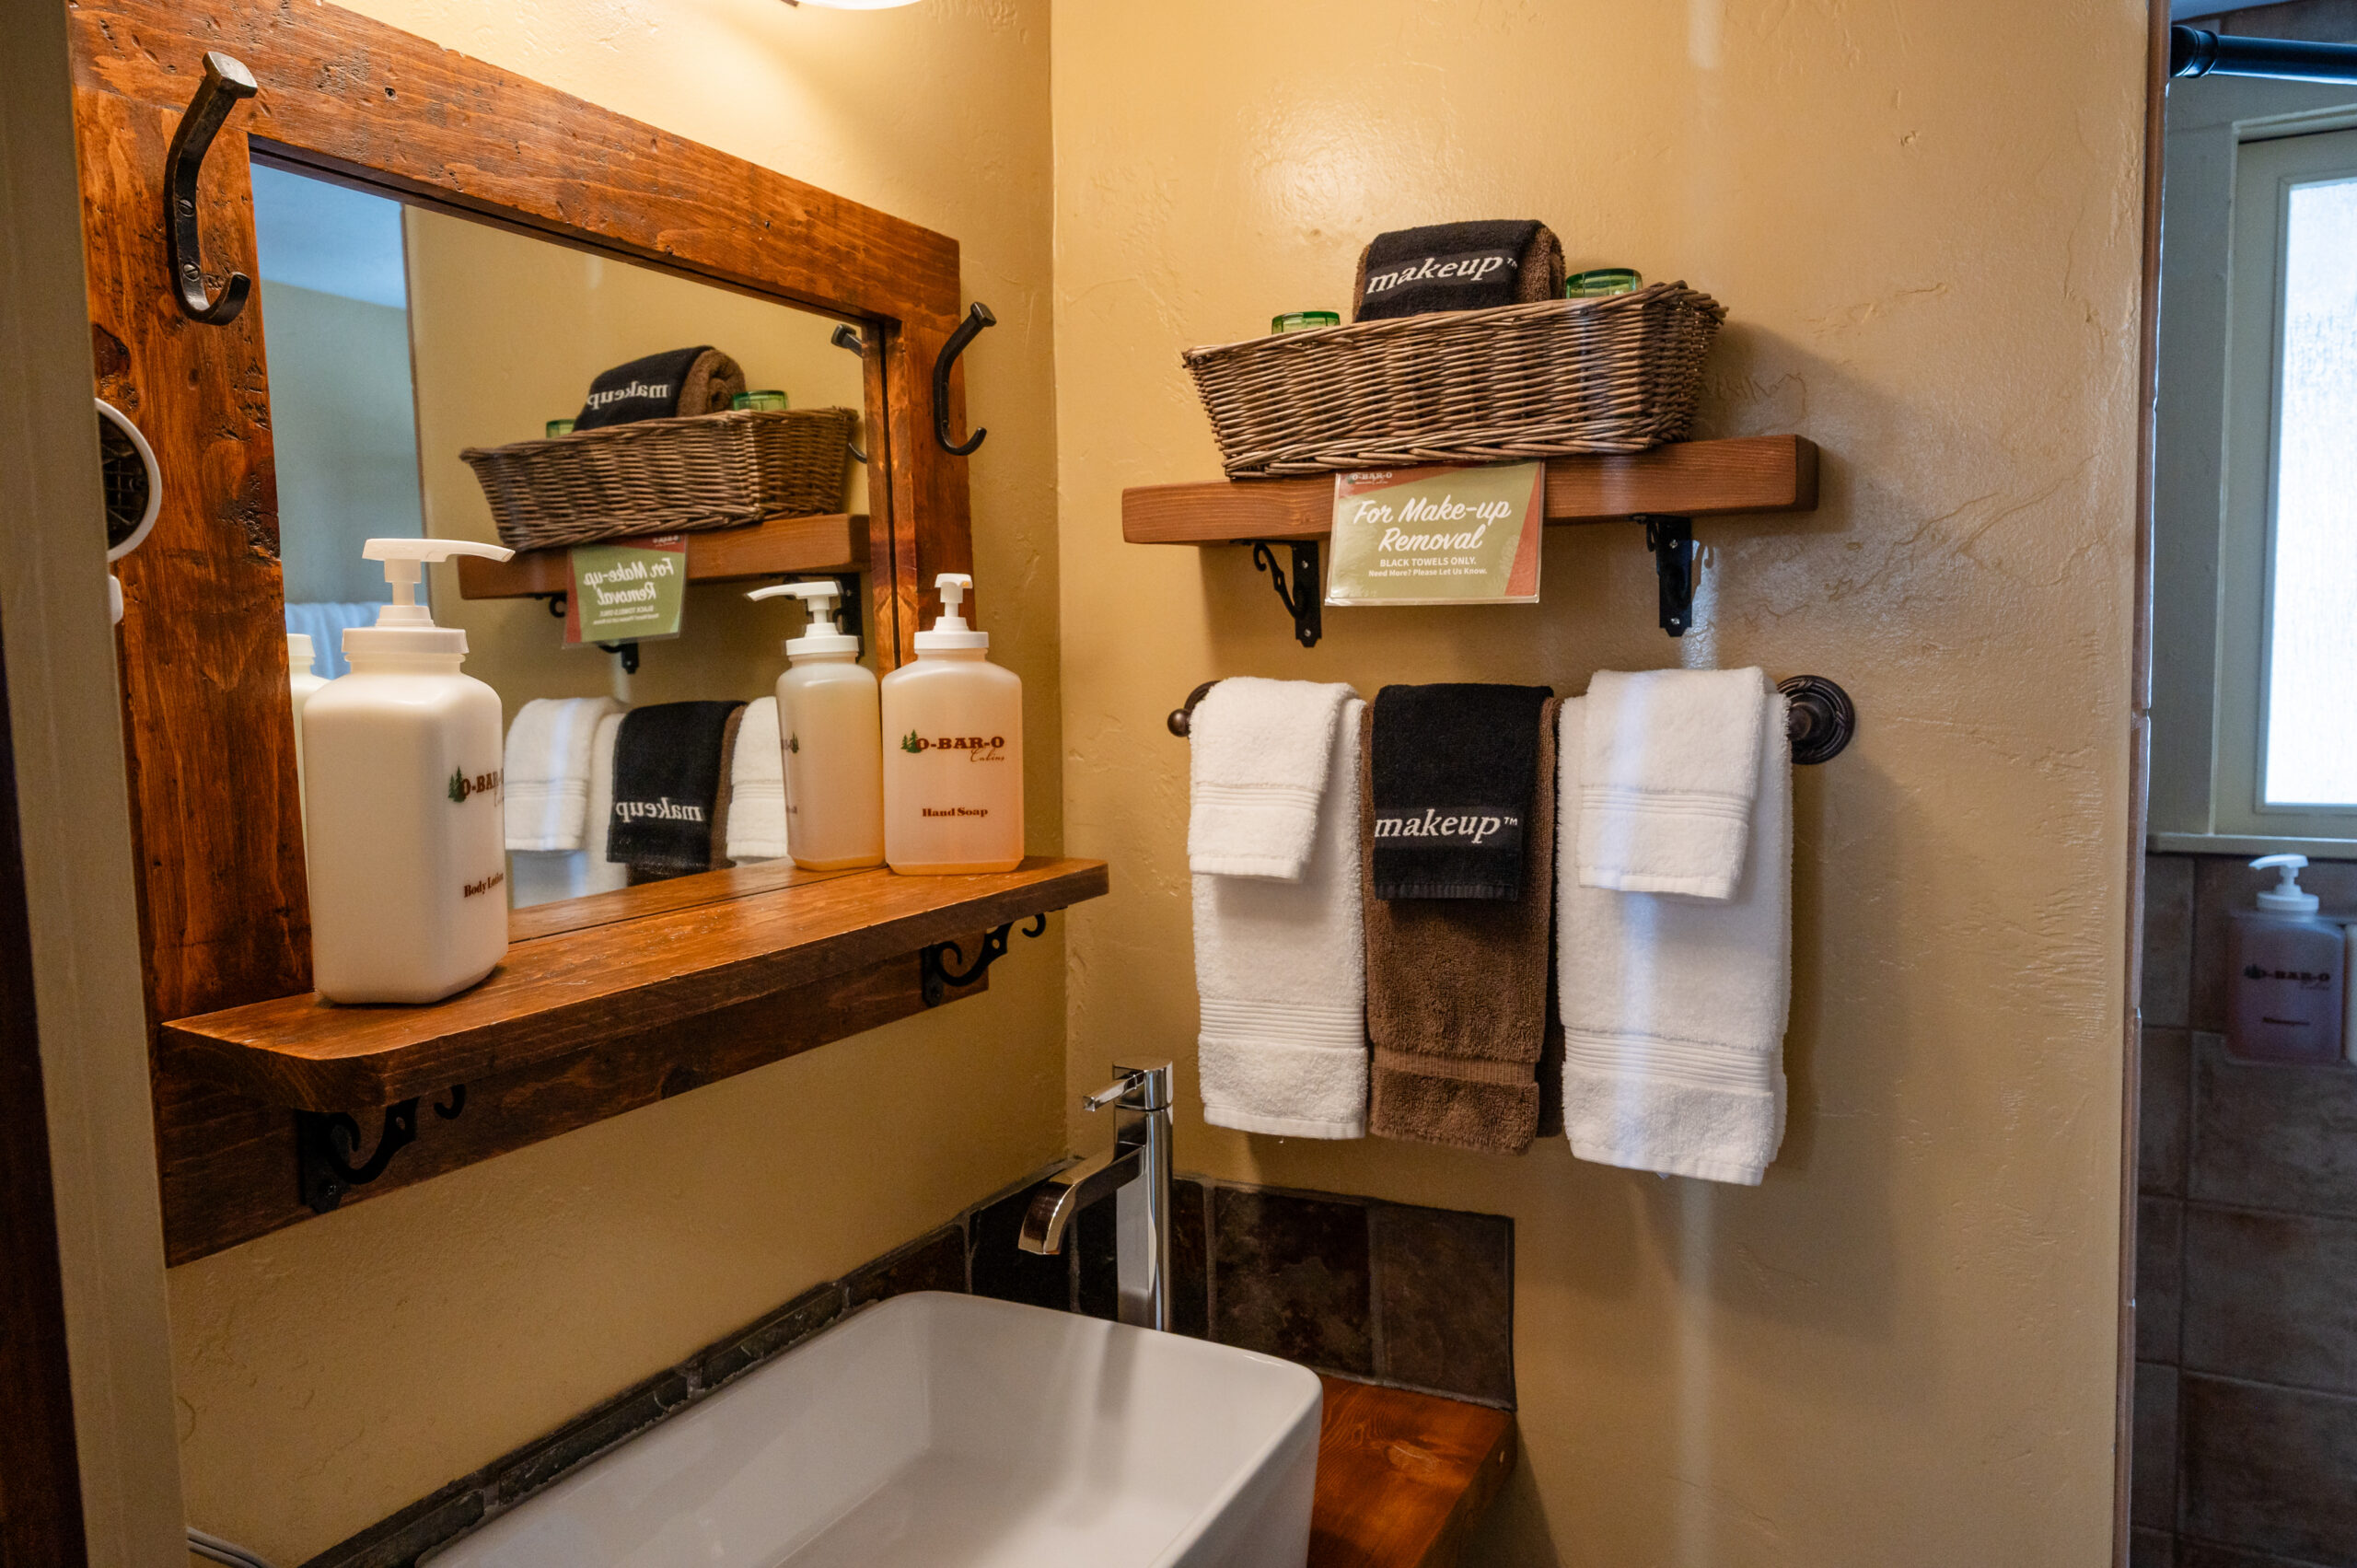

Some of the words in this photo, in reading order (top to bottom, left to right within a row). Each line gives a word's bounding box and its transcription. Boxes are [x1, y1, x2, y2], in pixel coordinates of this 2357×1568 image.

[1353, 499, 1394, 525] For
[1398, 494, 1512, 527] Make-up
[1377, 523, 1487, 552] Removal
[1380, 559, 1410, 568] BLACK
[1411, 557, 1449, 567] TOWELS
[1450, 556, 1477, 566] ONLY.
[1368, 569, 1387, 577] Need
[1388, 568, 1411, 577] More?
[1412, 568, 1437, 577] Please
[1439, 567, 1451, 576] Let
[1452, 567, 1462, 575] Us
[1463, 566, 1488, 575] Know.
[915, 736, 1005, 750] O-BAR-O
[970, 747, 1005, 762] Cabins
[922, 807, 956, 818] Hand
[957, 807, 989, 818] Soap
[463, 880, 487, 898] Body
